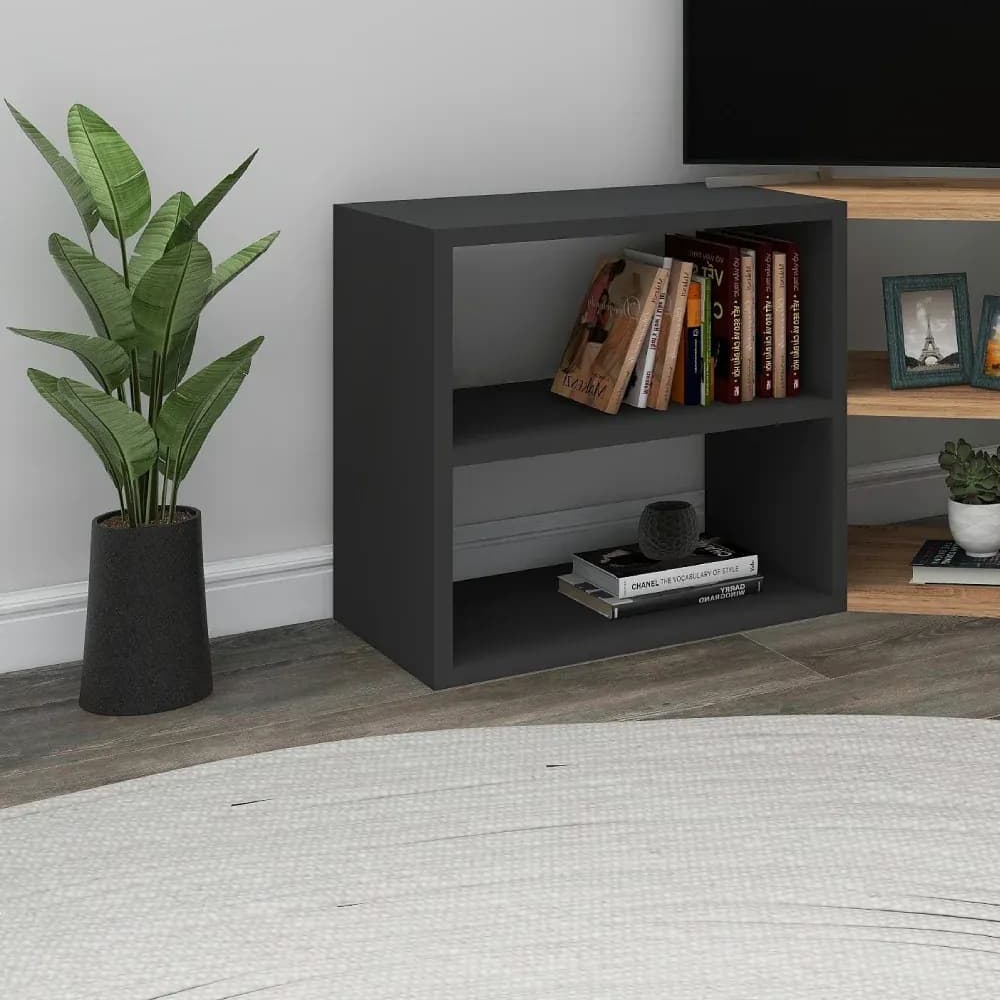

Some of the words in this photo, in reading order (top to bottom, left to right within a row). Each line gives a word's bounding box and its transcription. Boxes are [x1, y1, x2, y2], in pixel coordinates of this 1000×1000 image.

[631, 580, 659, 591] CHANEL
[660, 577, 672, 585] THE
[673, 570, 711, 583] VOCABULARY
[712, 568, 721, 576] OF
[722, 565, 740, 575] STYLE
